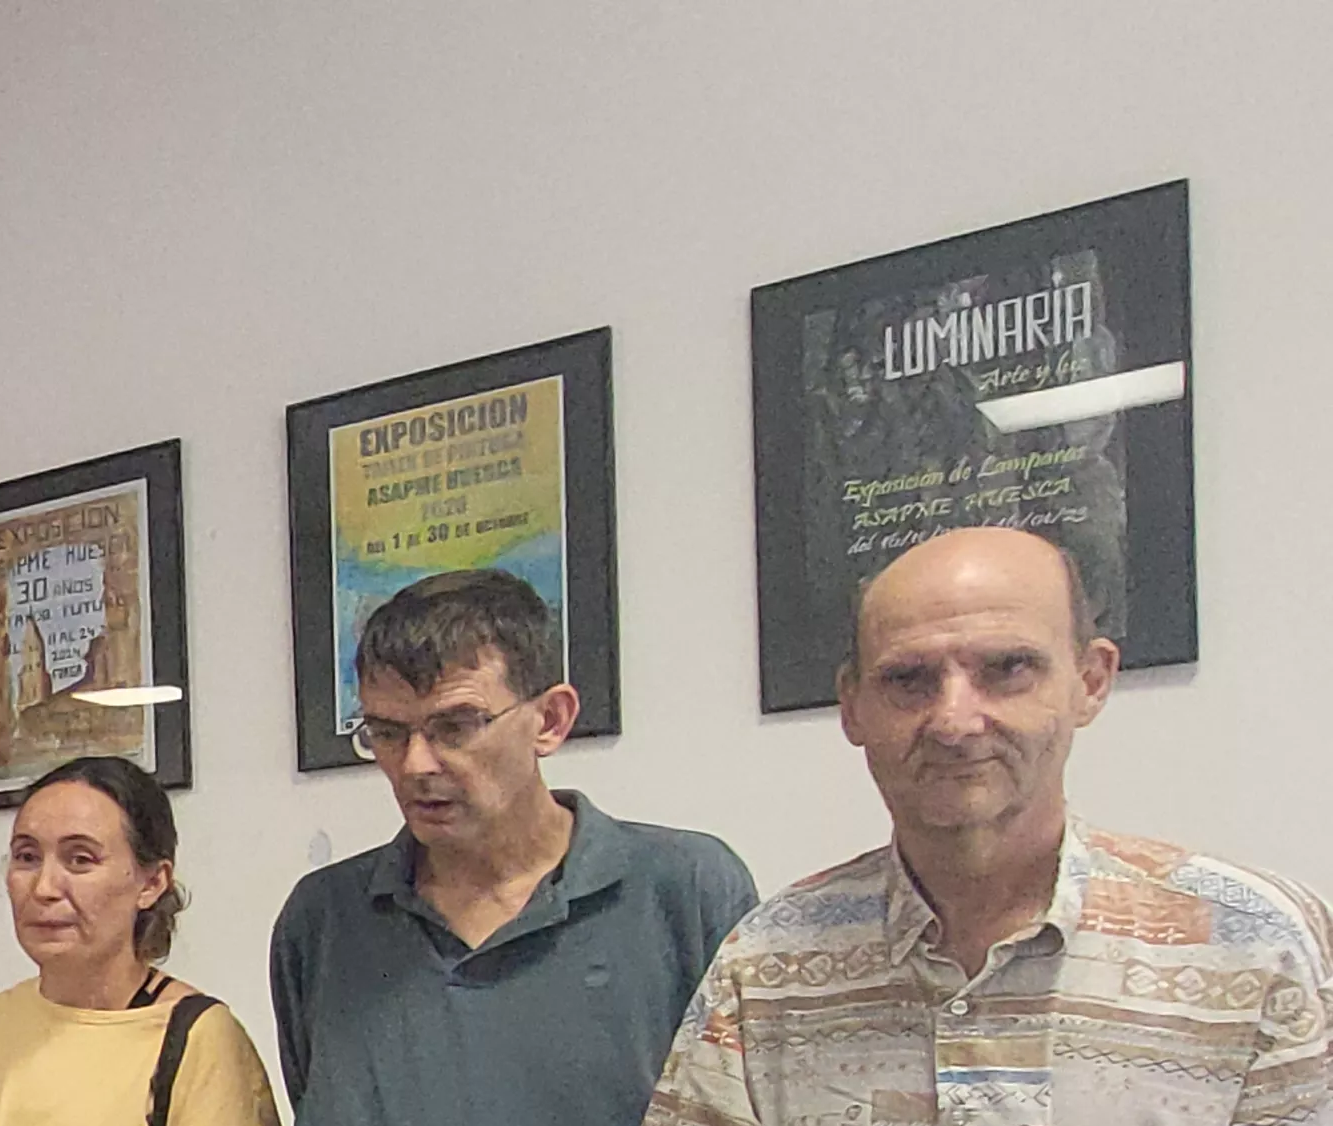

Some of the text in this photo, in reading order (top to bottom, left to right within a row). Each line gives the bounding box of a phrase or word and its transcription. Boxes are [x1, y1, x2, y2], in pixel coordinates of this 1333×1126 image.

[359, 391, 528, 457] EXPOSICION
[393, 532, 401, 549] 1
[427, 522, 450, 543] 30
[17, 577, 48, 605] 30
